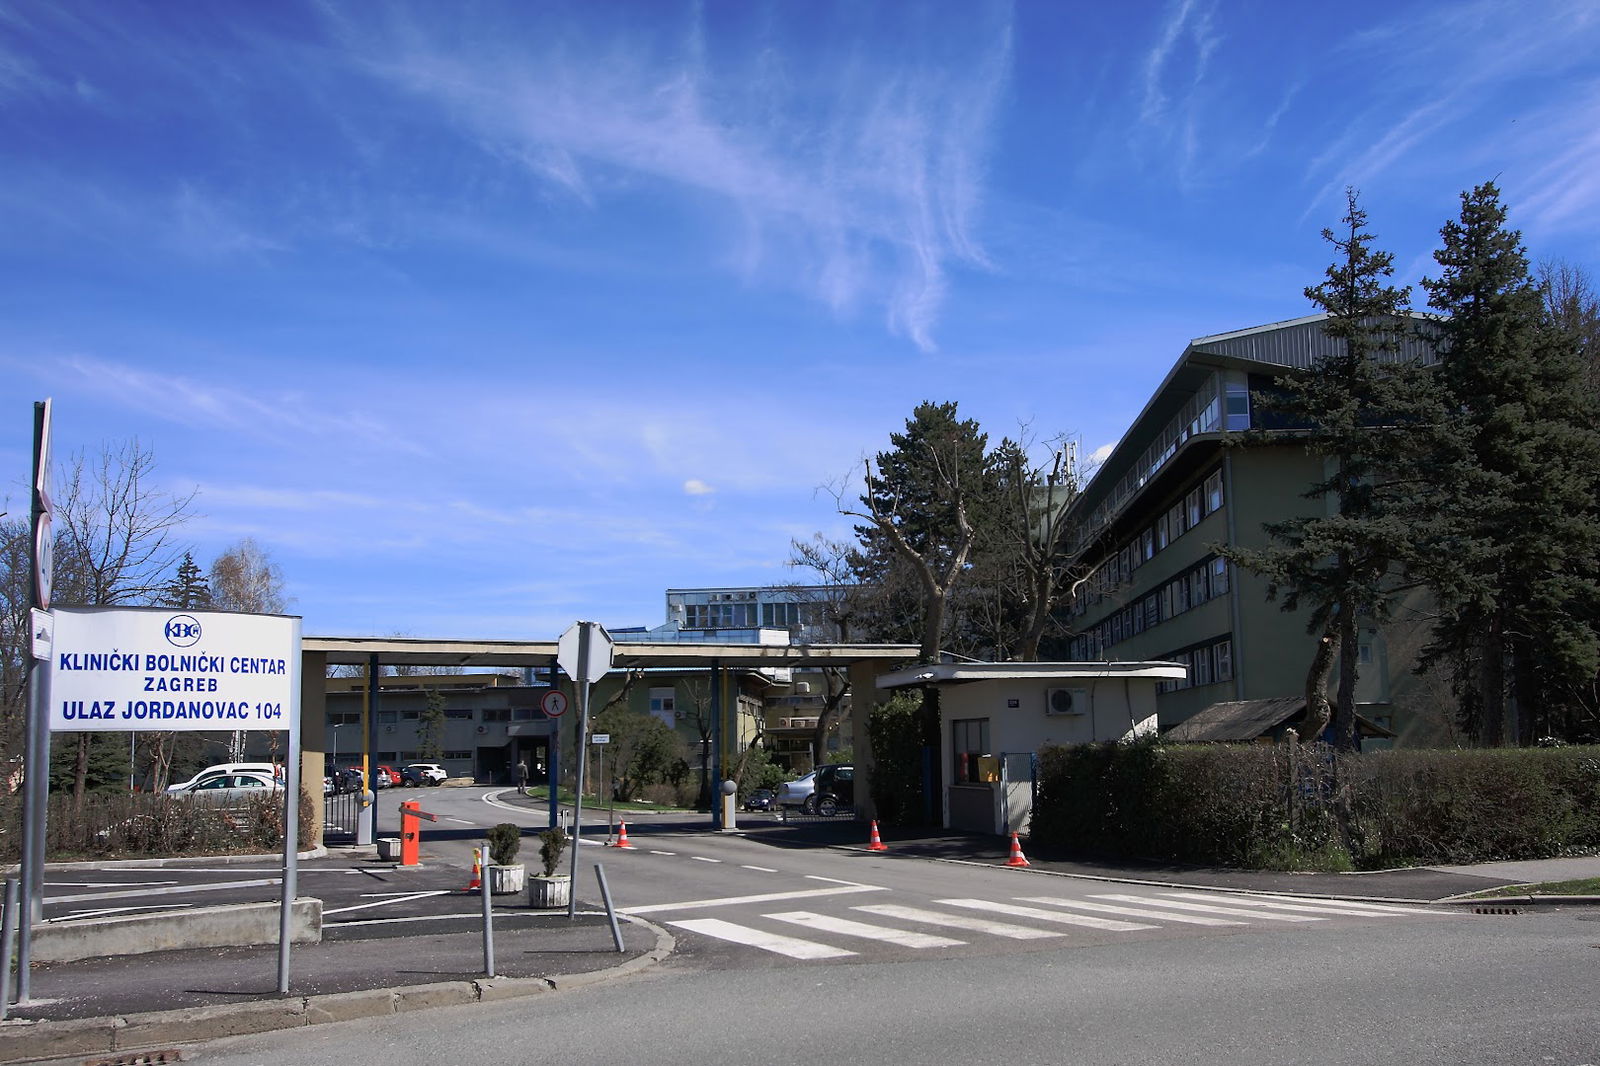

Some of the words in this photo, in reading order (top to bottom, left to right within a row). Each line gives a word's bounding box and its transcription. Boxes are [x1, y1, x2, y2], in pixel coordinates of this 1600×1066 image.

[60, 648, 139, 671] KLINIČKI
[145, 651, 224, 673] BOLNIČKI
[230, 657, 286, 675] CENTAR
[144, 677, 217, 692] ZAGREB
[63, 701, 115, 720] ULAZ
[122, 701, 249, 719] JORDANOVAC
[256, 702, 281, 719] 104
